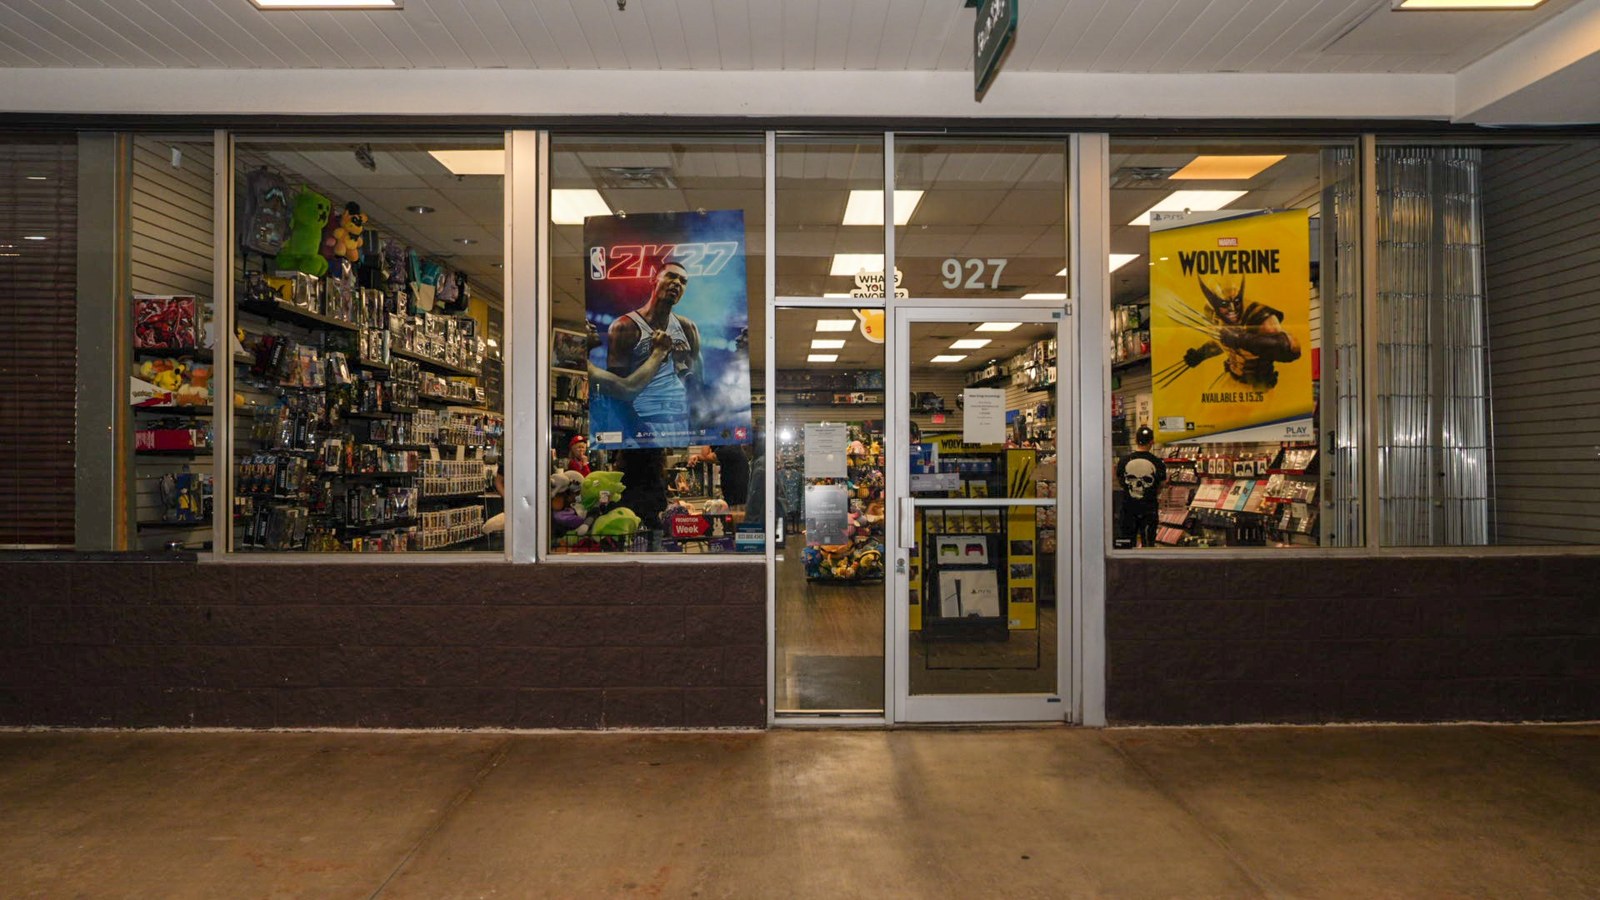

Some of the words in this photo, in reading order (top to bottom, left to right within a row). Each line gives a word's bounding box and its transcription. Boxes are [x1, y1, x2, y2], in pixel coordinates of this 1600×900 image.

[1218, 238, 1237, 246] MARVEL
[607, 241, 739, 280] 2K27
[1178, 249, 1280, 276] WOLVERINE
[859, 275, 899, 283] WHAS
[941, 257, 1008, 290] 927
[1201, 392, 1237, 404] AVAILABLE
[1238, 391, 1264, 403] 9.15.26
[1286, 426, 1307, 434] PLAY
[675, 525, 699, 534] Week
